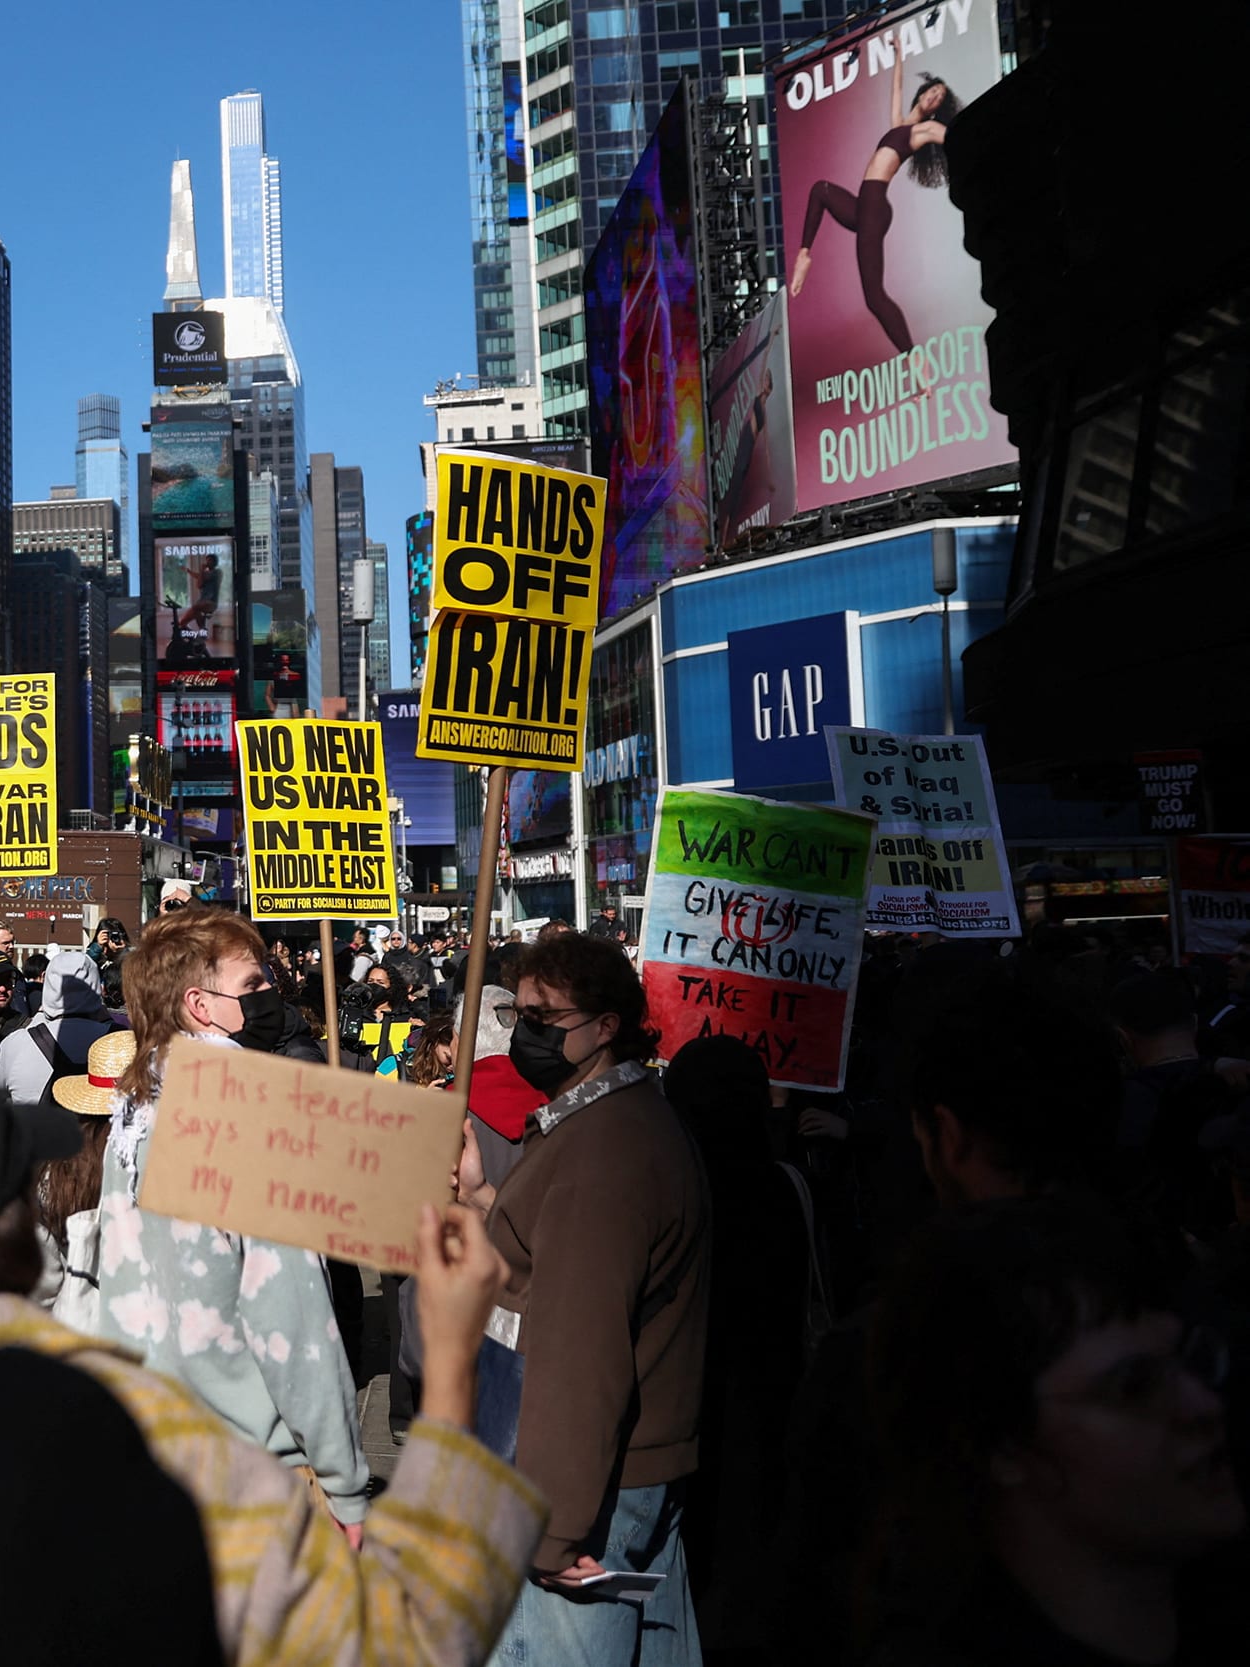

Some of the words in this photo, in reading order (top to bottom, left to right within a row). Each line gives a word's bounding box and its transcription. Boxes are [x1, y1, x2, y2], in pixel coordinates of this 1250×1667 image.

[786, 51, 860, 110] OLD
[867, 0, 973, 77] NAVY
[163, 351, 218, 363] Prudential
[843, 326, 984, 415] POWERSOFT
[816, 374, 842, 404] NEW
[819, 381, 990, 484] BOUNDLESS
[447, 463, 596, 560] HANDS
[165, 544, 223, 556] SAMSUNG
[443, 547, 591, 615] OFF
[181, 629, 198, 639] Stay
[199, 629, 208, 637] fit
[431, 609, 585, 726] IRAN!
[0, 680, 48, 694] FOR
[387, 703, 420, 719] SAM
[752, 663, 823, 742] GAP
[245, 725, 294, 773] NO
[303, 725, 375, 775] NEW
[430, 720, 575, 758] ANSWERCOALITION.ORG
[849, 735, 907, 757] U.S.
[585, 747, 606, 789] OLD
[607, 733, 641, 783] NAVY
[1137, 763, 1198, 781] TRUMP
[249, 774, 300, 810] US
[301, 776, 382, 811] WAR
[863, 766, 895, 786] of
[905, 767, 959, 795] Iraq
[1144, 781, 1194, 798] MUST
[860, 795, 882, 815] &
[891, 796, 974, 822] Syria!
[1157, 799, 1183, 813] GO
[252, 821, 299, 850] IN
[303, 821, 385, 852] THE
[1150, 813, 1197, 832] NOW!
[677, 820, 755, 868] WAR
[762, 833, 861, 880] CAN'T
[943, 839, 984, 862] Off
[254, 854, 336, 889] MIDDLE
[339, 855, 385, 890] EAST
[888, 861, 965, 891] IRAN!
[47, 876, 96, 902] PIECE
[274, 898, 296, 910] PARTY
[297, 898, 311, 909] FOR
[312, 896, 346, 910] SOCIALISM
[347, 898, 352, 909] &
[353, 898, 390, 910] LIBERATION
[685, 881, 754, 916] GIVE
[763, 897, 840, 940] LIFE,
[877, 902, 930, 912] SOCIALISMO
[937, 907, 990, 917] SOCIALISM
[940, 901, 971, 909] STRUGGLE
[663, 930, 697, 957] IT
[711, 936, 772, 974] CAN
[778, 949, 846, 988] ONLY
[678, 975, 750, 1012] TAKE
[771, 990, 805, 1022] IT
[699, 1015, 797, 1069] AAY
[181, 1057, 269, 1102] This
[285, 1068, 416, 1130] teacher
[266, 1125, 324, 1160] not
[348, 1138, 381, 1175] in
